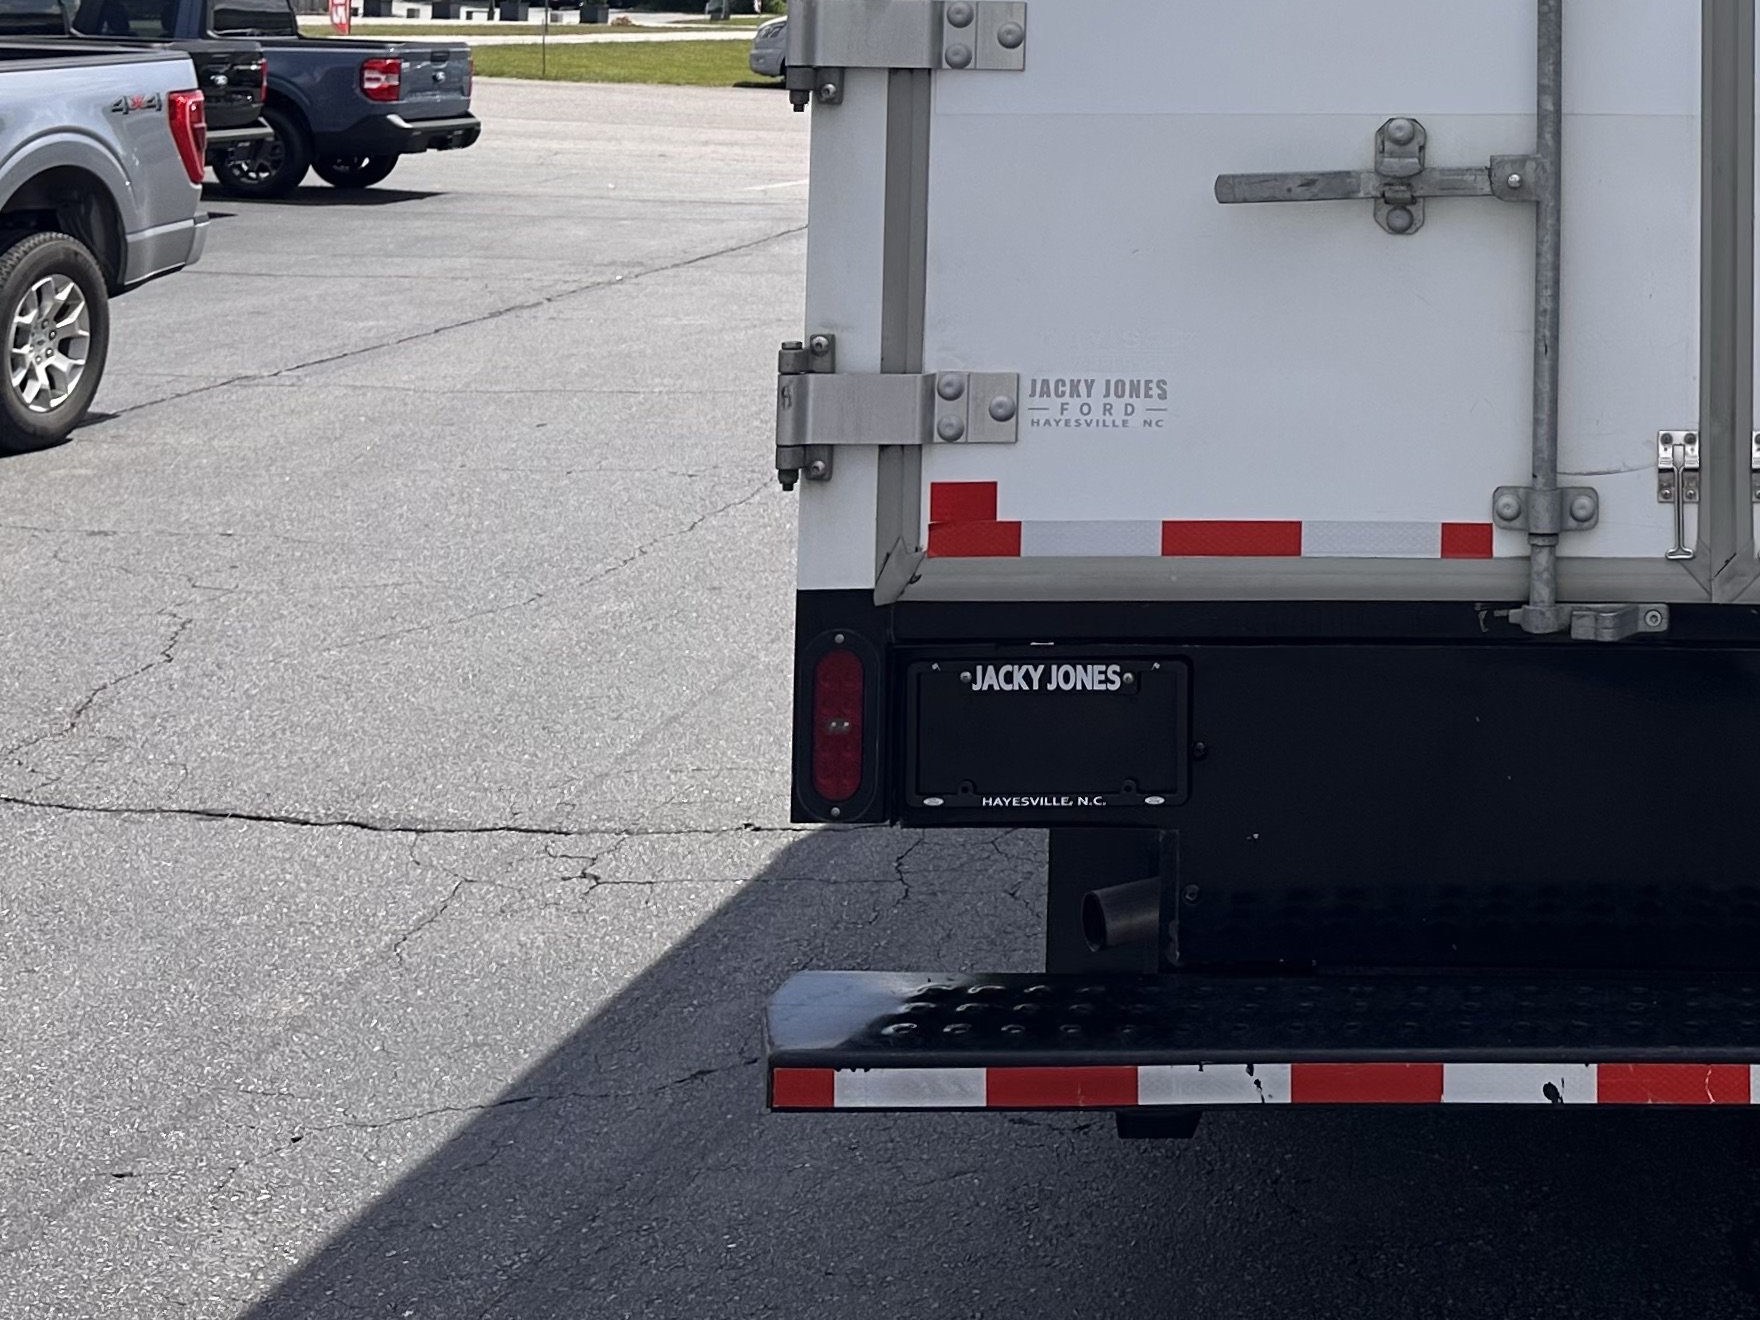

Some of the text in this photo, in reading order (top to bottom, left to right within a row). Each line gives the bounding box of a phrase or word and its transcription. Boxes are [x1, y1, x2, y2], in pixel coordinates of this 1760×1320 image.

[1029, 378, 1168, 400] JACKY JONES
[1060, 402, 1136, 417] FORD
[1030, 418, 1165, 428] HAYESVILLE NC
[971, 664, 1121, 691] JACKY JONES
[1077, 796, 1107, 807] N.C.
